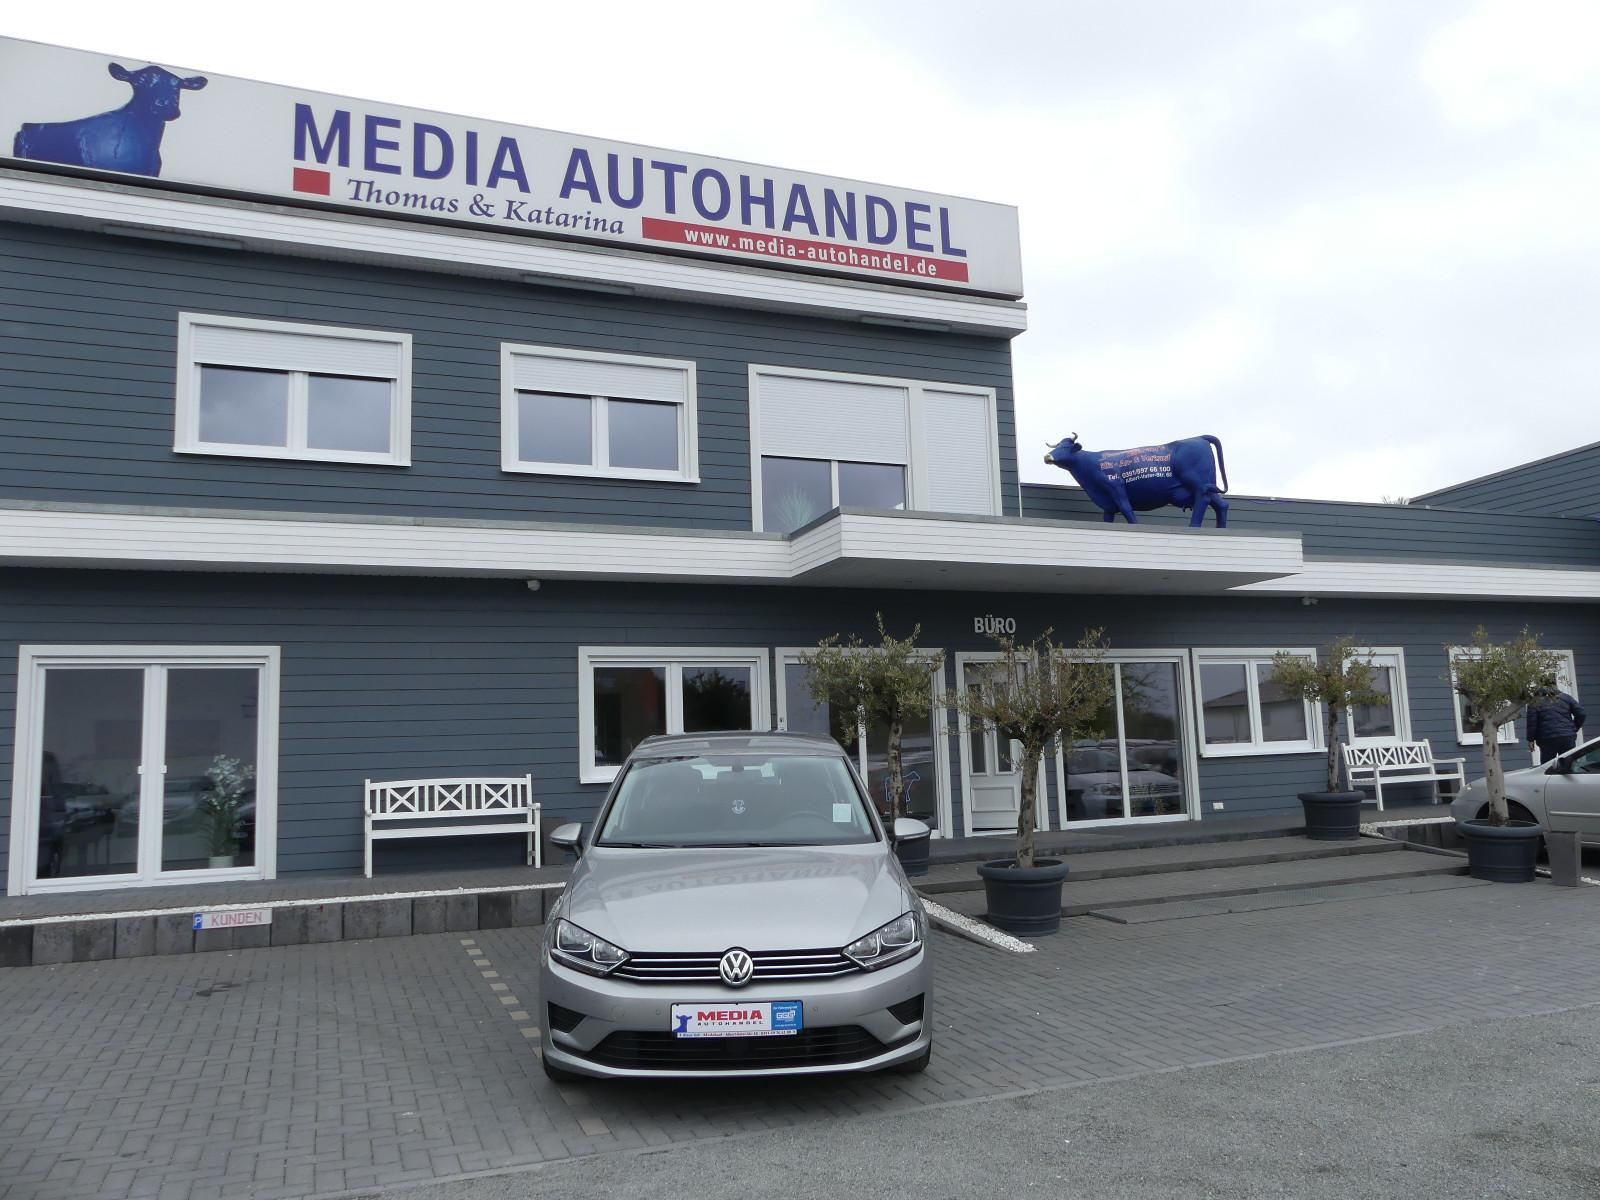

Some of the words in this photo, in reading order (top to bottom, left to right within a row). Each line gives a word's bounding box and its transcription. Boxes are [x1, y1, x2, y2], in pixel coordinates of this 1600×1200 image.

[293, 102, 531, 194] MEDIA
[559, 147, 968, 258] AUTOHANDEL
[347, 178, 459, 213] Thomas
[468, 194, 495, 218] &
[503, 199, 625, 235] Katarina
[684, 227, 938, 277] www.media-autohandel.de
[974, 614, 1016, 634] BÜRO
[194, 915, 202, 927] P
[211, 911, 262, 927] KUNDEN
[697, 1010, 763, 1021] MEDIA
